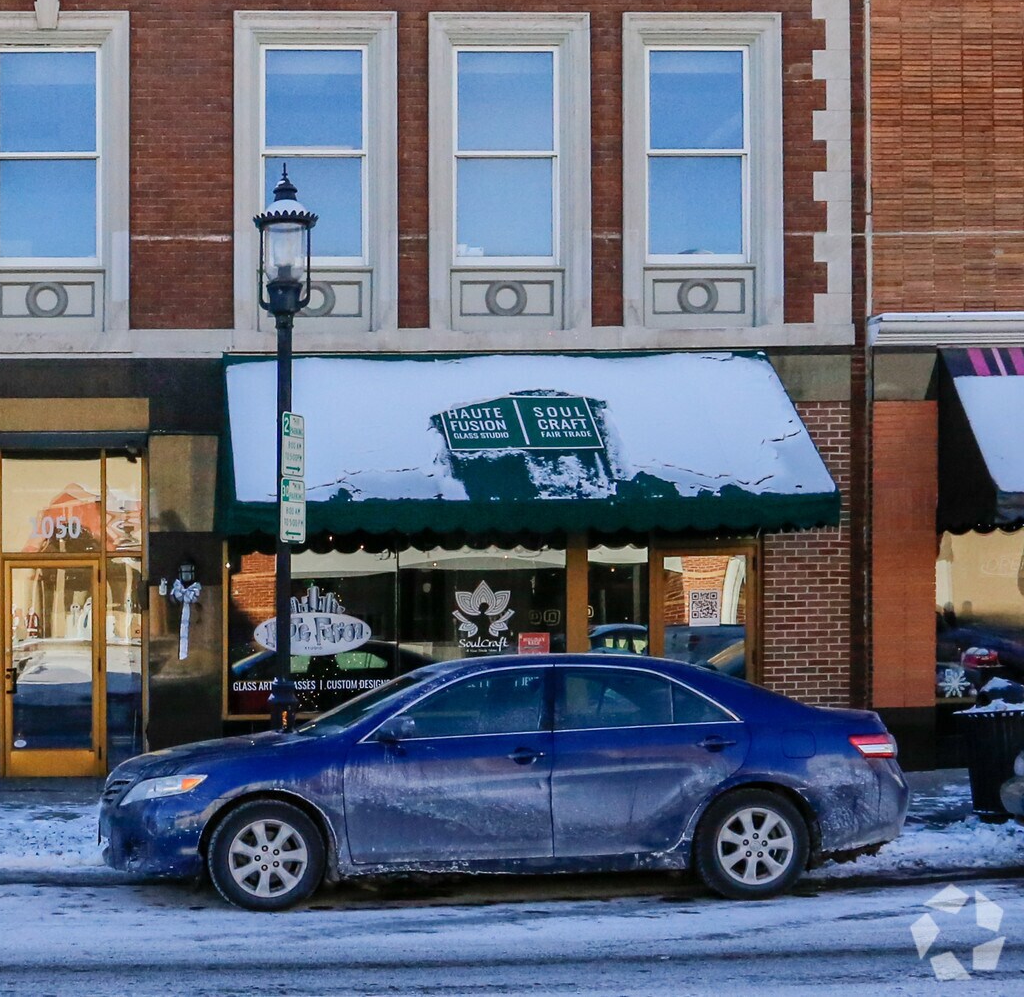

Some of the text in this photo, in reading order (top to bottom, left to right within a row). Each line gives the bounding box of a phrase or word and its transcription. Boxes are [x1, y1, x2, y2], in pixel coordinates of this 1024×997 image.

[447, 407, 503, 419] HAUTE
[533, 406, 585, 418] SOUL
[284, 417, 290, 433] 2
[450, 420, 507, 432] FUSION
[538, 419, 587, 431] CRAFT
[453, 431, 510, 440] GLASS STUDIO
[563, 430, 593, 438] TRADE
[29, 516, 82, 540] 1050
[458, 636, 510, 653] SoulCraft
[233, 682, 257, 692] GLASS
[258, 682, 273, 691] ART
[326, 679, 358, 690] CUSTOM
